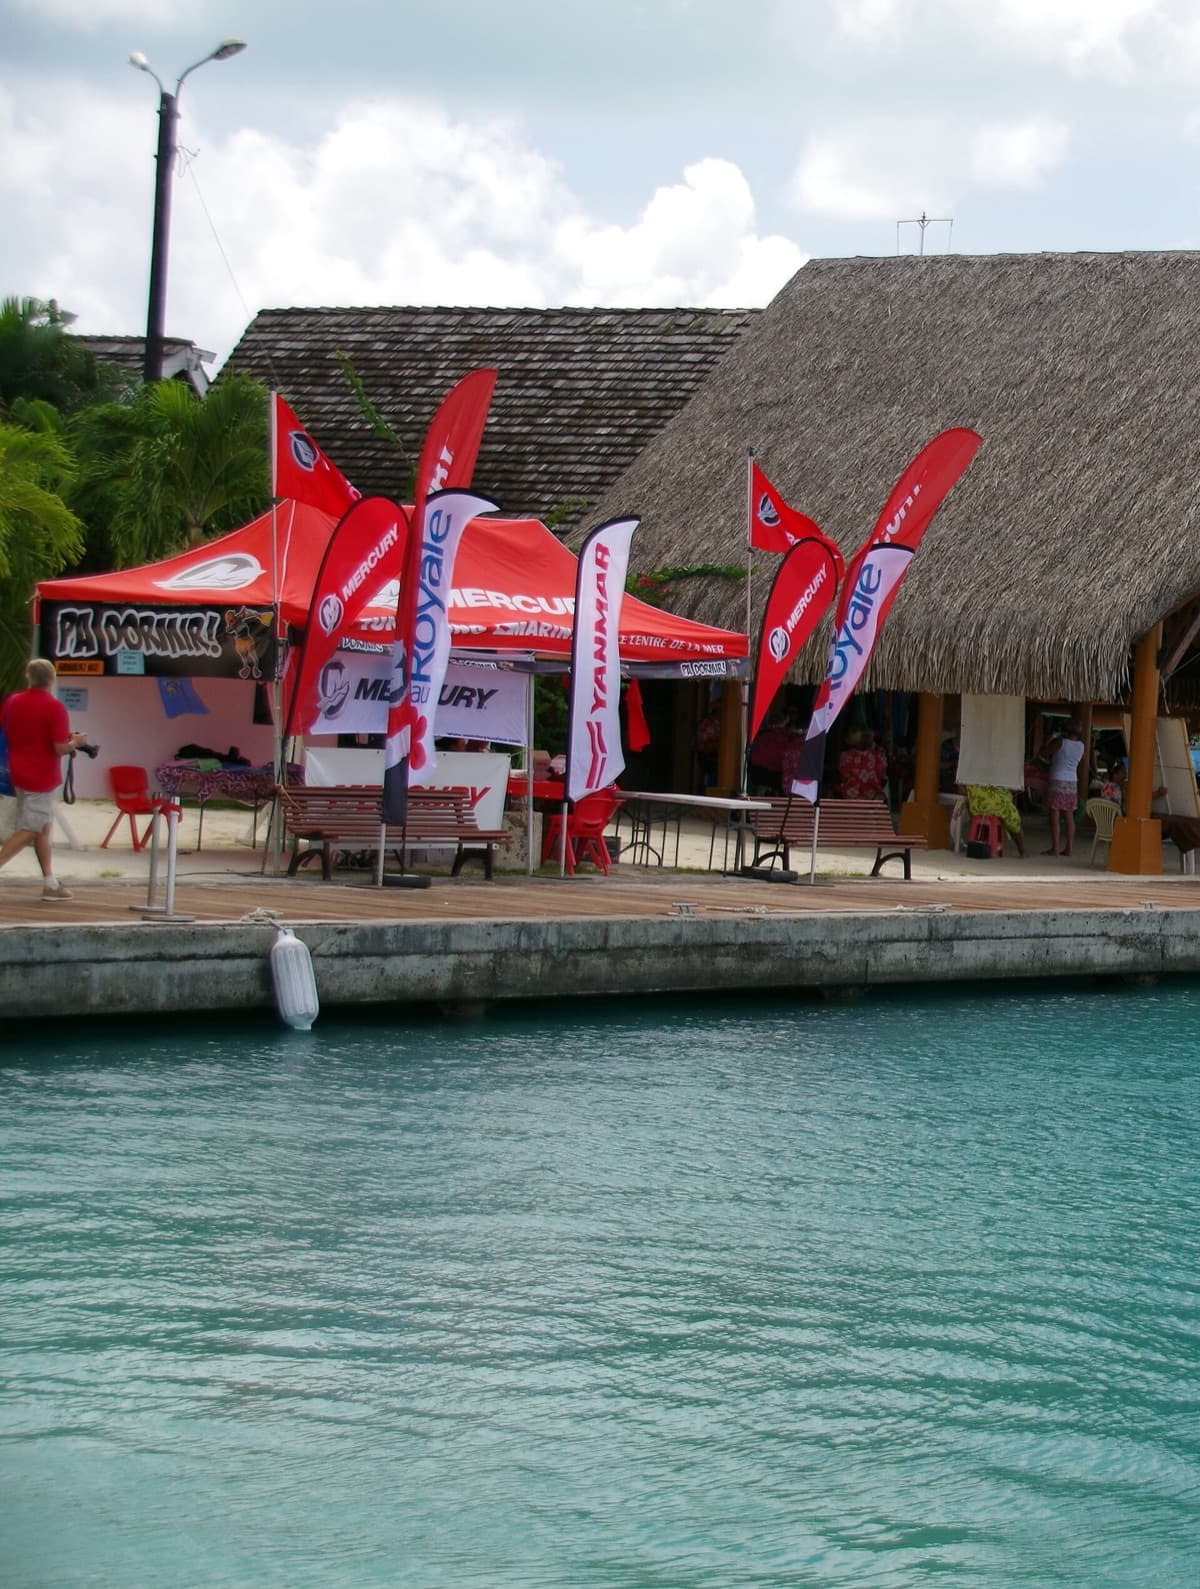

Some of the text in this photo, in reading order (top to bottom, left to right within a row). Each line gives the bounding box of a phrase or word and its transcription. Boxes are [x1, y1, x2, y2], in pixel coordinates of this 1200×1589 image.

[341, 522, 398, 602] MERCURY
[449, 588, 576, 616] MERCU
[786, 562, 826, 633] MERCURY
[56, 608, 223, 659] PA DORMIR!
[511, 619, 574, 641] MARIN
[590, 542, 611, 714] YANMAR
[629, 635, 668, 649] CENTRE
[668, 639, 686, 650] DE
[701, 644, 725, 655] MER
[829, 563, 882, 691] oyale
[680, 662, 694, 677] PA
[354, 677, 499, 710] MEURY
